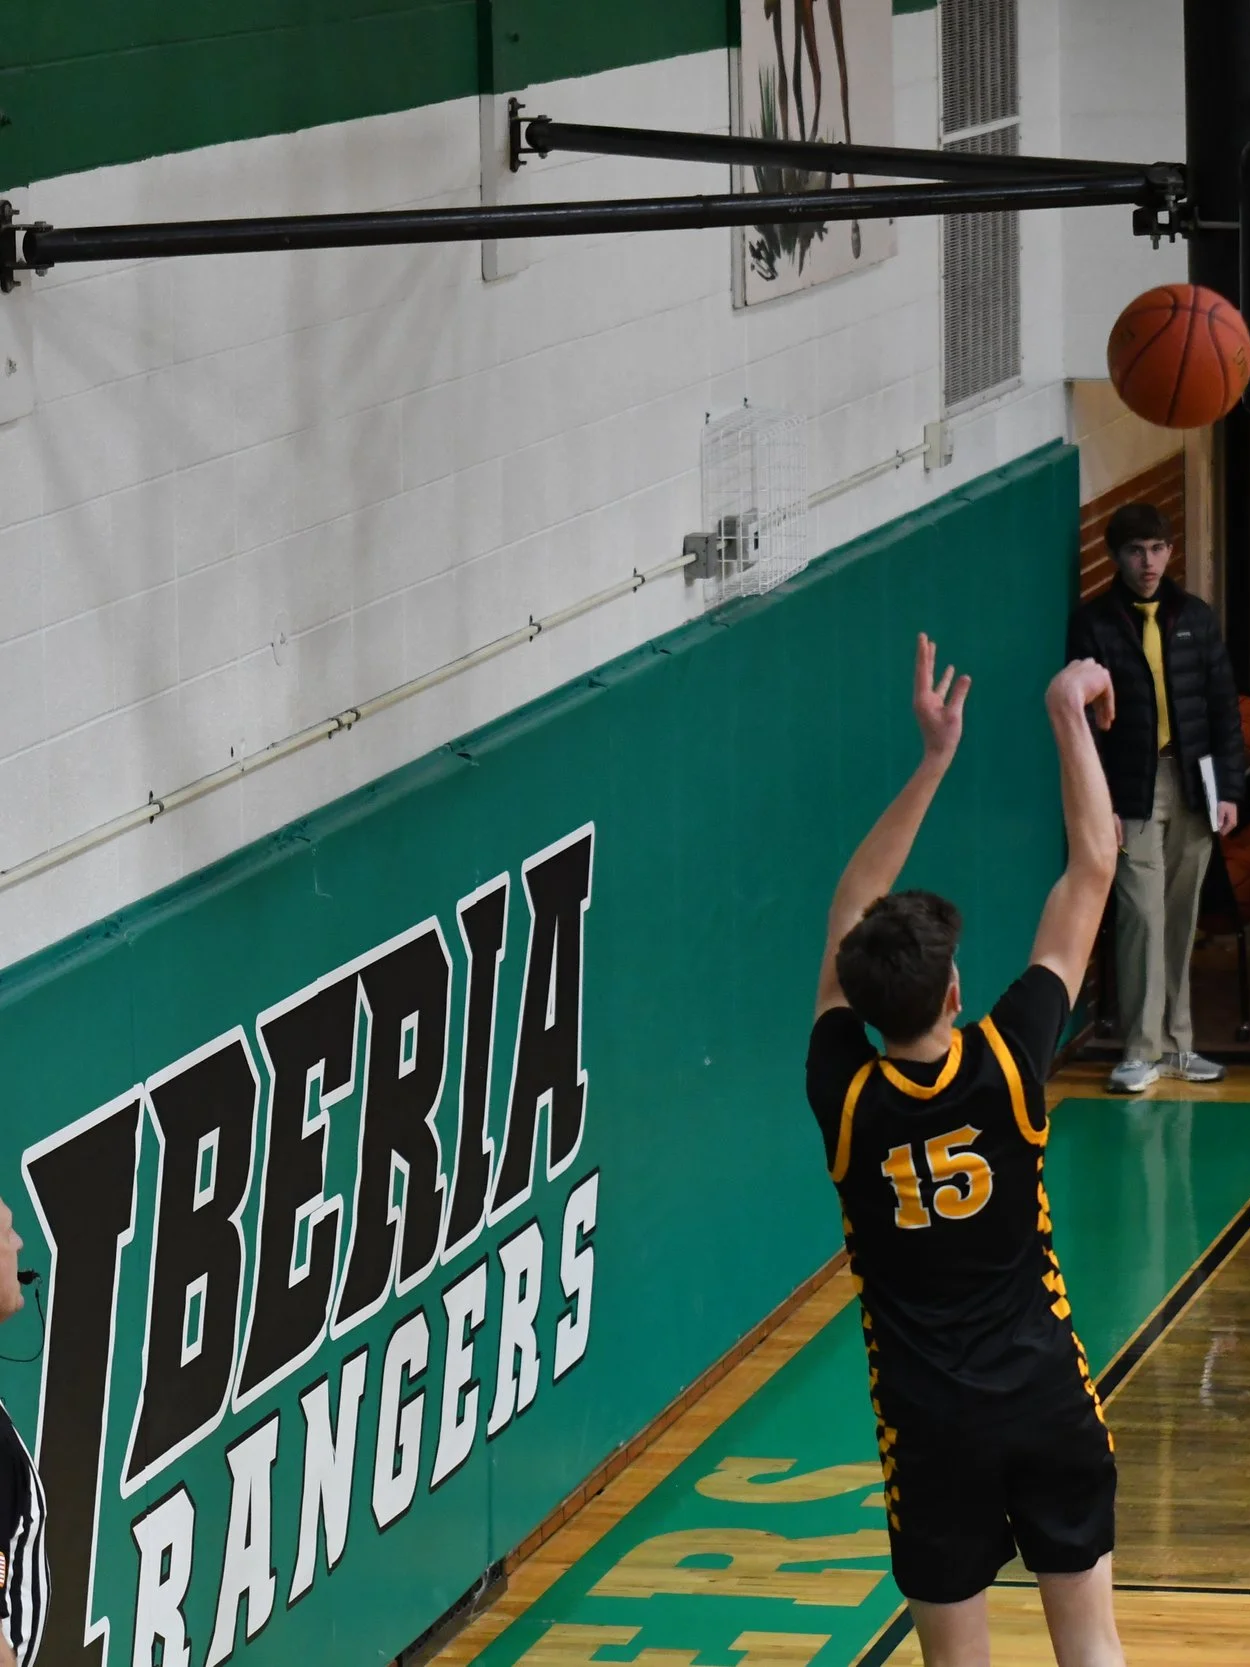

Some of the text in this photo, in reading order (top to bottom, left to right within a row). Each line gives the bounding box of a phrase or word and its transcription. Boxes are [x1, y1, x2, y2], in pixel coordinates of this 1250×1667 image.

[22, 821, 596, 1667] IBERIA
[131, 1168, 600, 1667] RANGERS
[881, 1124, 994, 1229] 15
